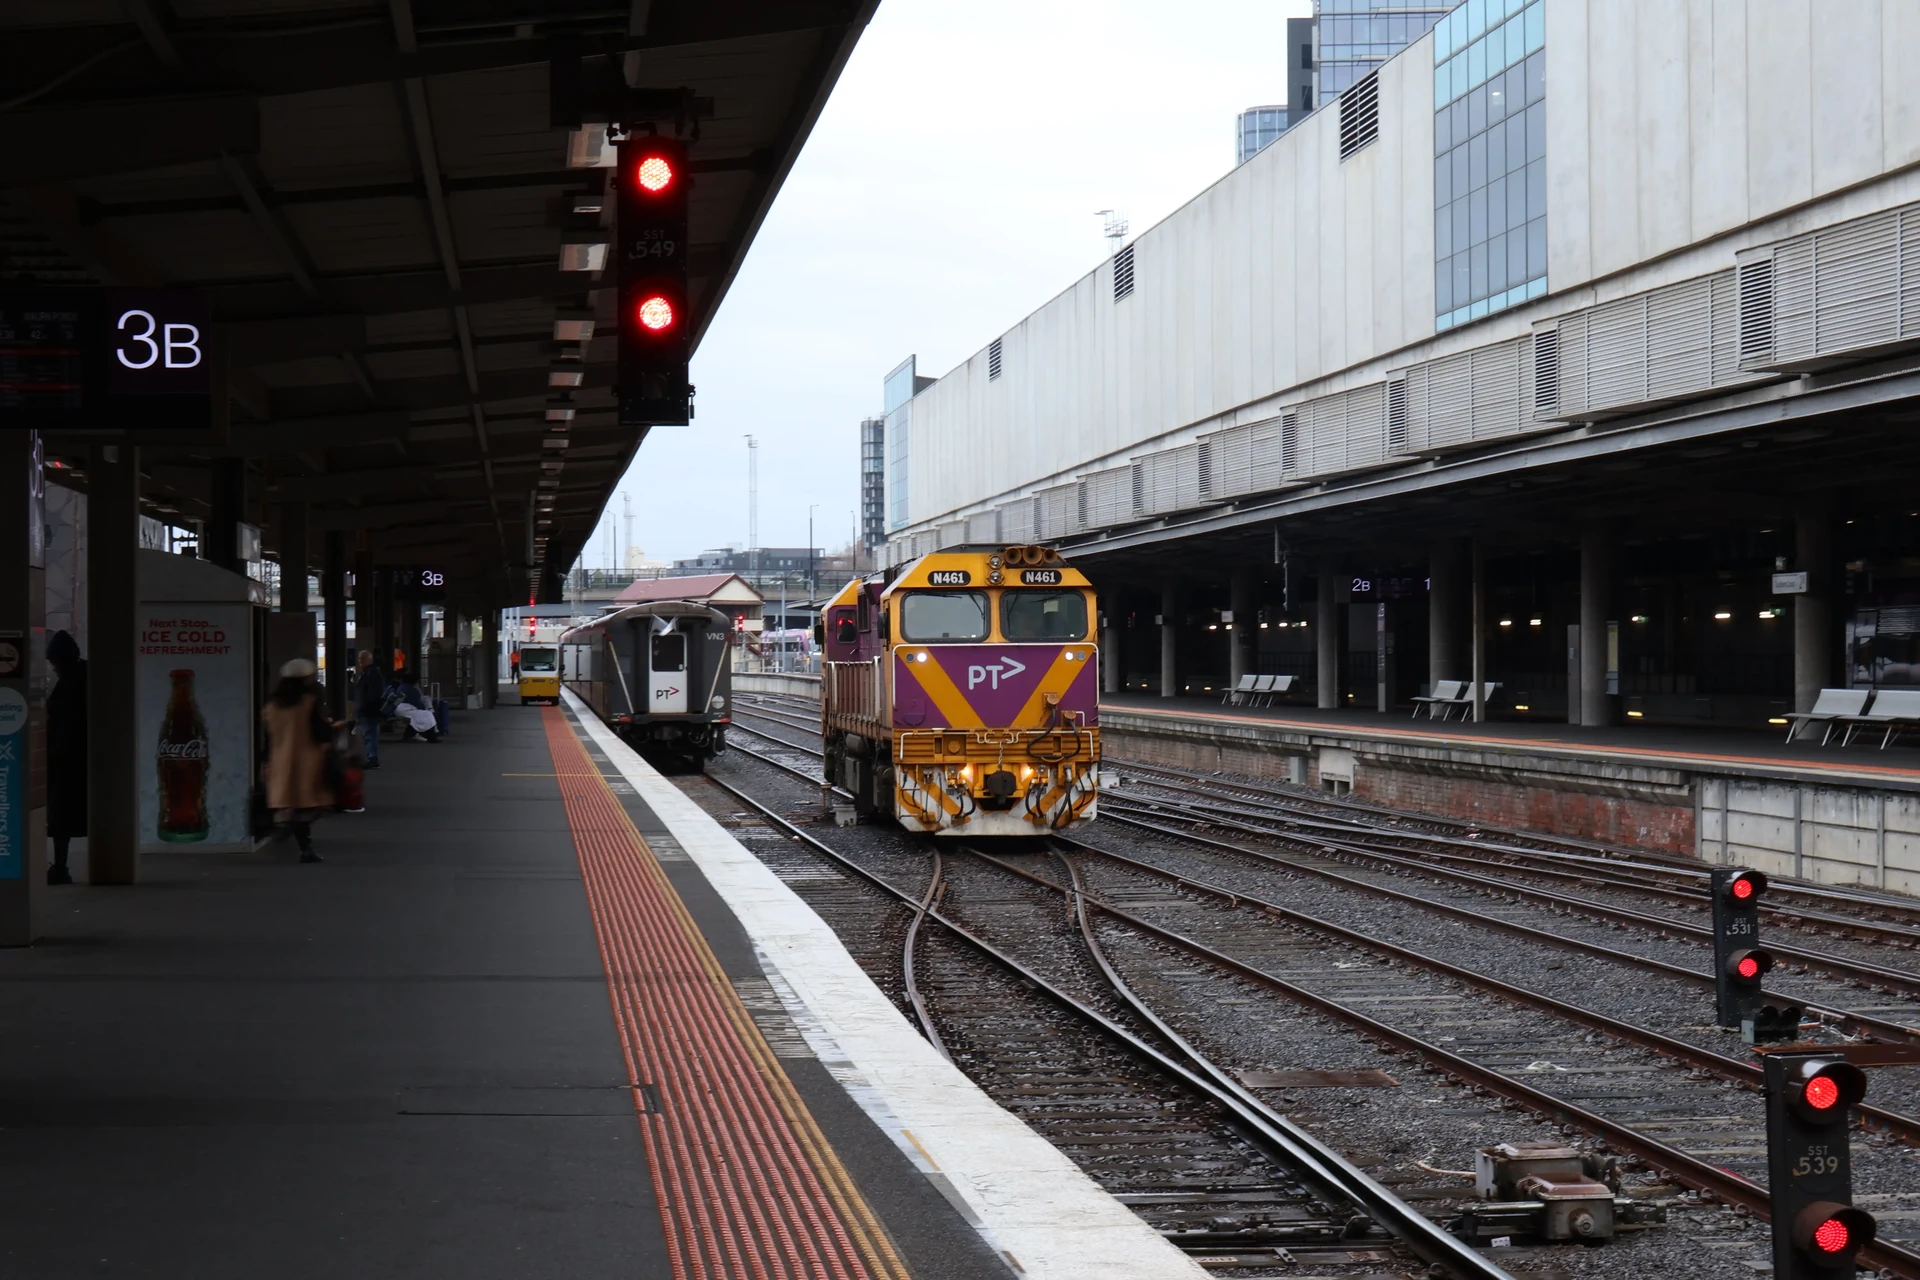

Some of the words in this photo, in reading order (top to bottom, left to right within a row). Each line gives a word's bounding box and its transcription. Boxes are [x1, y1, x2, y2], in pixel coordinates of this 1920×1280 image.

[643, 229, 665, 240] SST
[635, 240, 676, 258] 549
[116, 309, 202, 369] 3B
[420, 569, 445, 586] 3B
[933, 572, 965, 584] N461
[1025, 570, 1057, 583] N461
[1352, 577, 1371, 592] 2B
[149, 619, 177, 628] Next
[142, 631, 171, 643] ICE
[177, 631, 226, 643] COLD
[706, 632, 725, 641] VN3
[1731, 923, 1751, 935] 531
[1807, 1145, 1829, 1156] SST
[1799, 1156, 1839, 1175] 539
